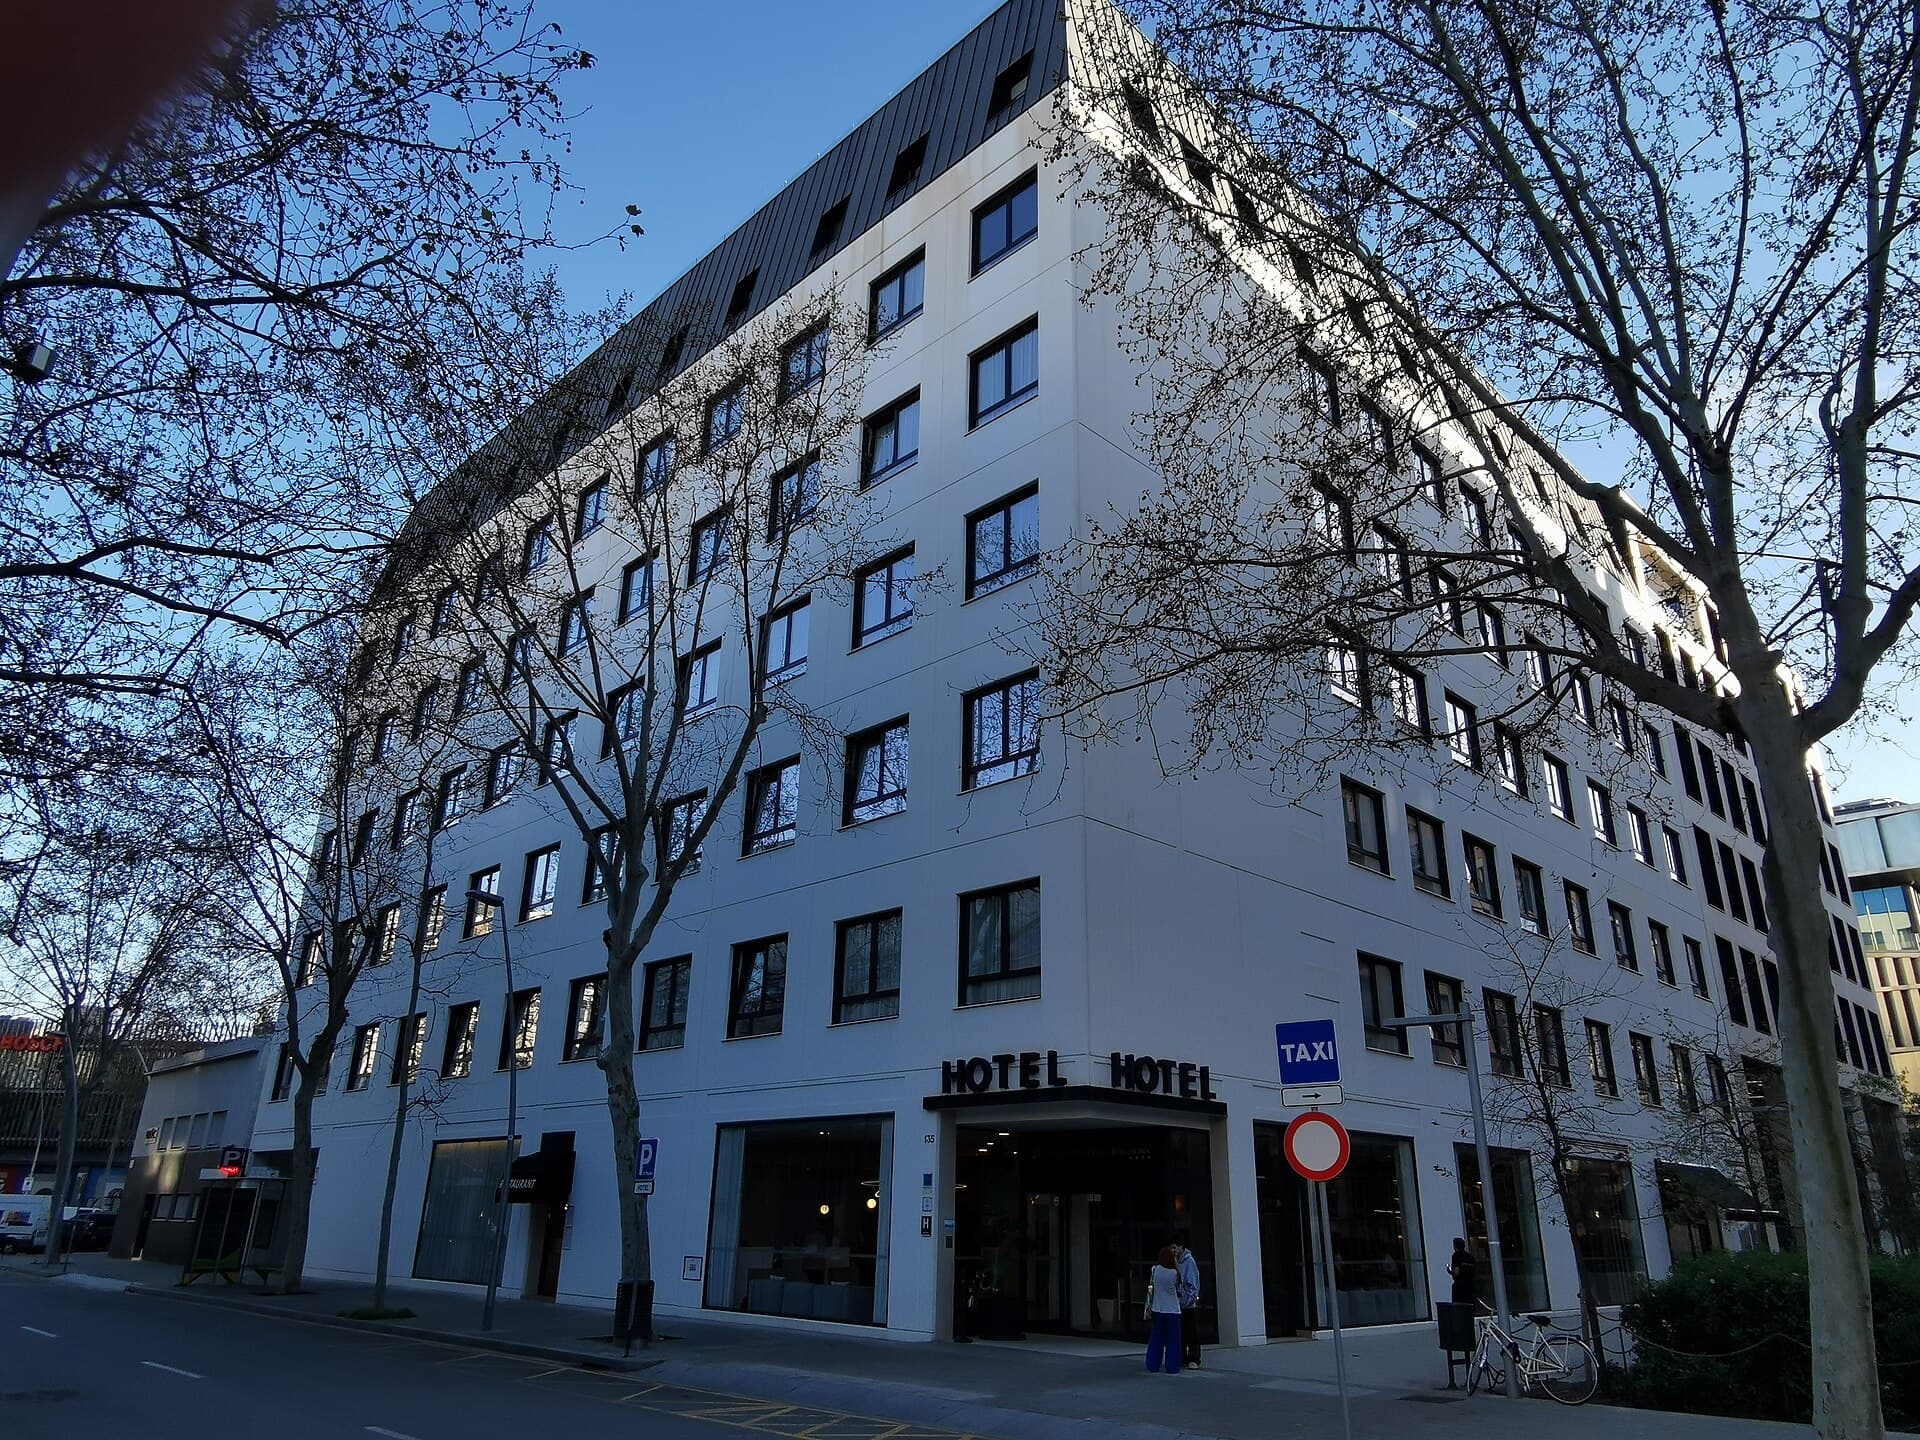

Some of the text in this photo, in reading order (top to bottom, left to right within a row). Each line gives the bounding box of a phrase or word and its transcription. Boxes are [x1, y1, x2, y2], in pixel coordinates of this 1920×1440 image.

[1281, 1041, 1334, 1062] TAXI
[942, 1050, 1067, 1094] HOTEL
[1110, 1052, 1216, 1100] HOTEL
[924, 1135, 935, 1144] 135
[223, 1150, 241, 1166] P
[639, 1144, 653, 1175] P
[922, 1217, 929, 1229] H
